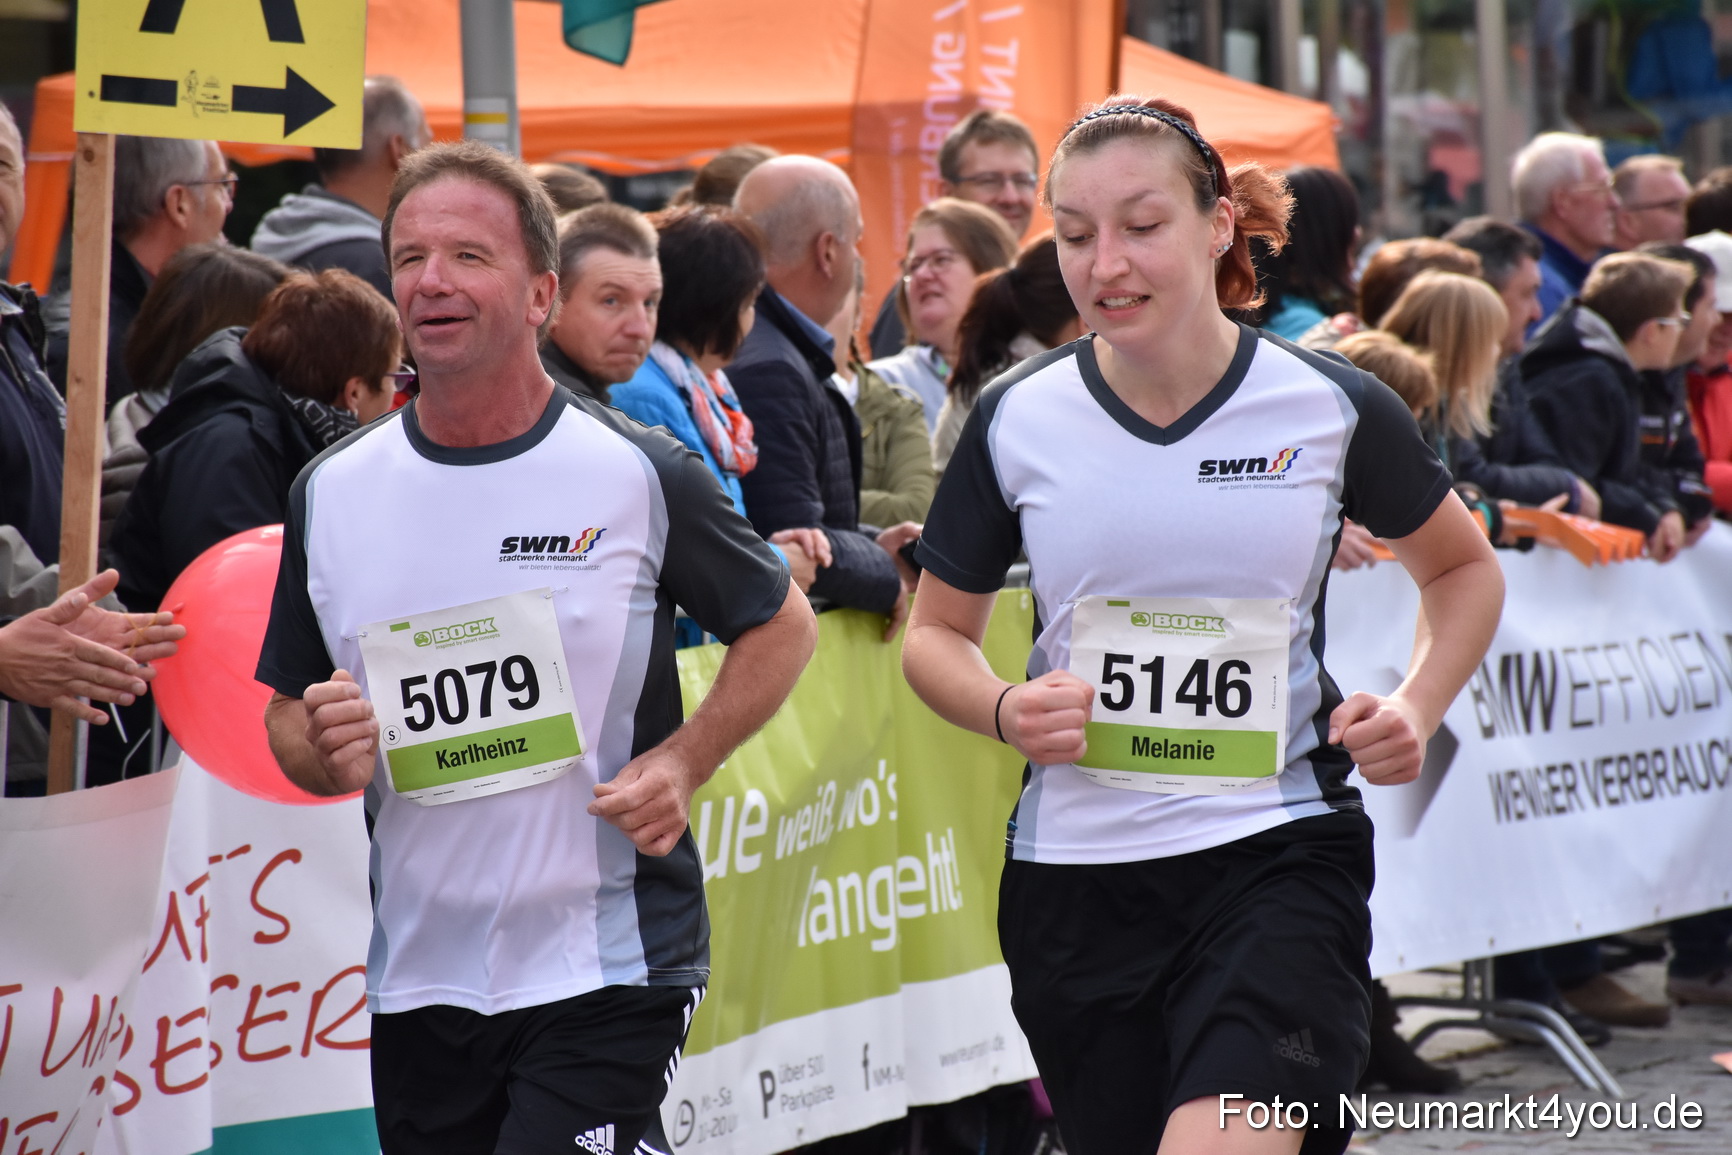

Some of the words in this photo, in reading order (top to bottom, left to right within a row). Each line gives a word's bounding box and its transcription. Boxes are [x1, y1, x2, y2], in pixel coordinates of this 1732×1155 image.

[1198, 457, 1268, 476] swn
[1197, 475, 1244, 483] stadtwerke
[1246, 473, 1286, 481] neumarkt
[499, 535, 571, 554] swn
[498, 554, 546, 563] stadtwerke
[547, 554, 588, 562] neumarkt
[530, 563, 552, 571] bieten
[431, 617, 498, 645] BOCK
[1152, 612, 1226, 633] BOCK
[435, 641, 456, 650] inspired
[463, 637, 478, 645] smart
[478, 633, 500, 641] concepts
[400, 654, 540, 732] 5079
[1100, 653, 1252, 718] 5146
[435, 737, 529, 771] Karlheinz
[1131, 735, 1215, 761] Melanie
[1272, 1043, 1321, 1068] adidas
